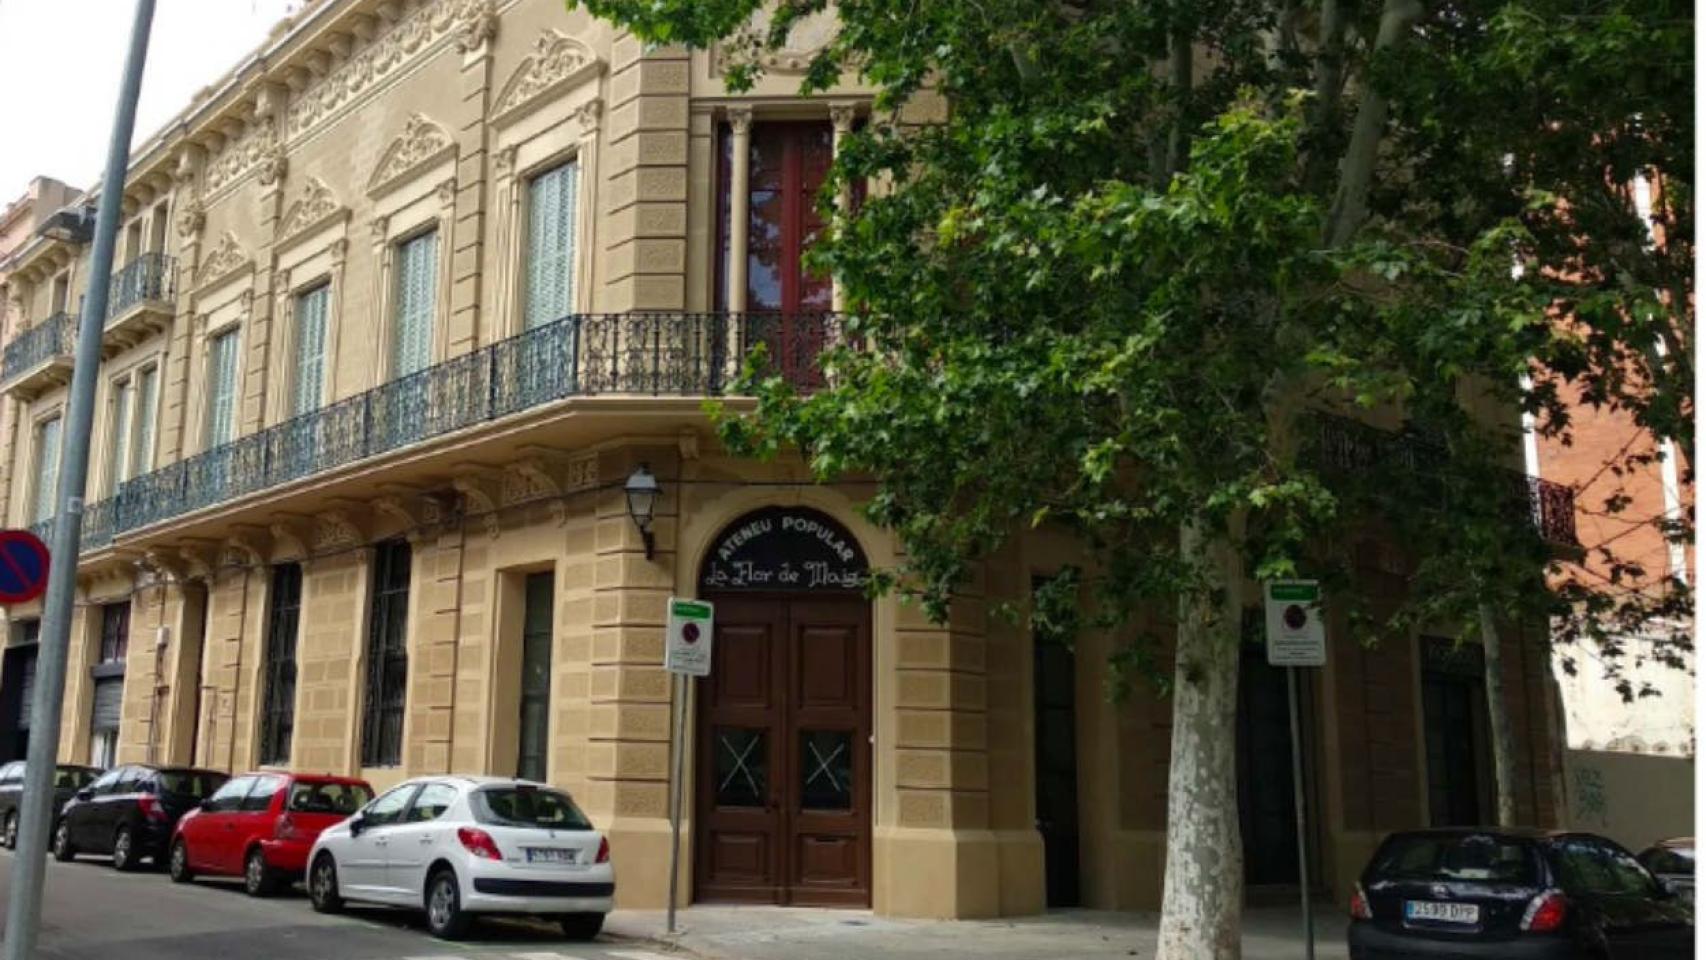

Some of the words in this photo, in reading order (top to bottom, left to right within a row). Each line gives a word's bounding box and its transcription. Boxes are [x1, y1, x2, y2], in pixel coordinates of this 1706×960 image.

[718, 518, 772, 561] ATENEU
[782, 516, 854, 562] POPULAR
[731, 561, 773, 586] Flor
[778, 562, 800, 583] de
[803, 561, 862, 587] Maig
